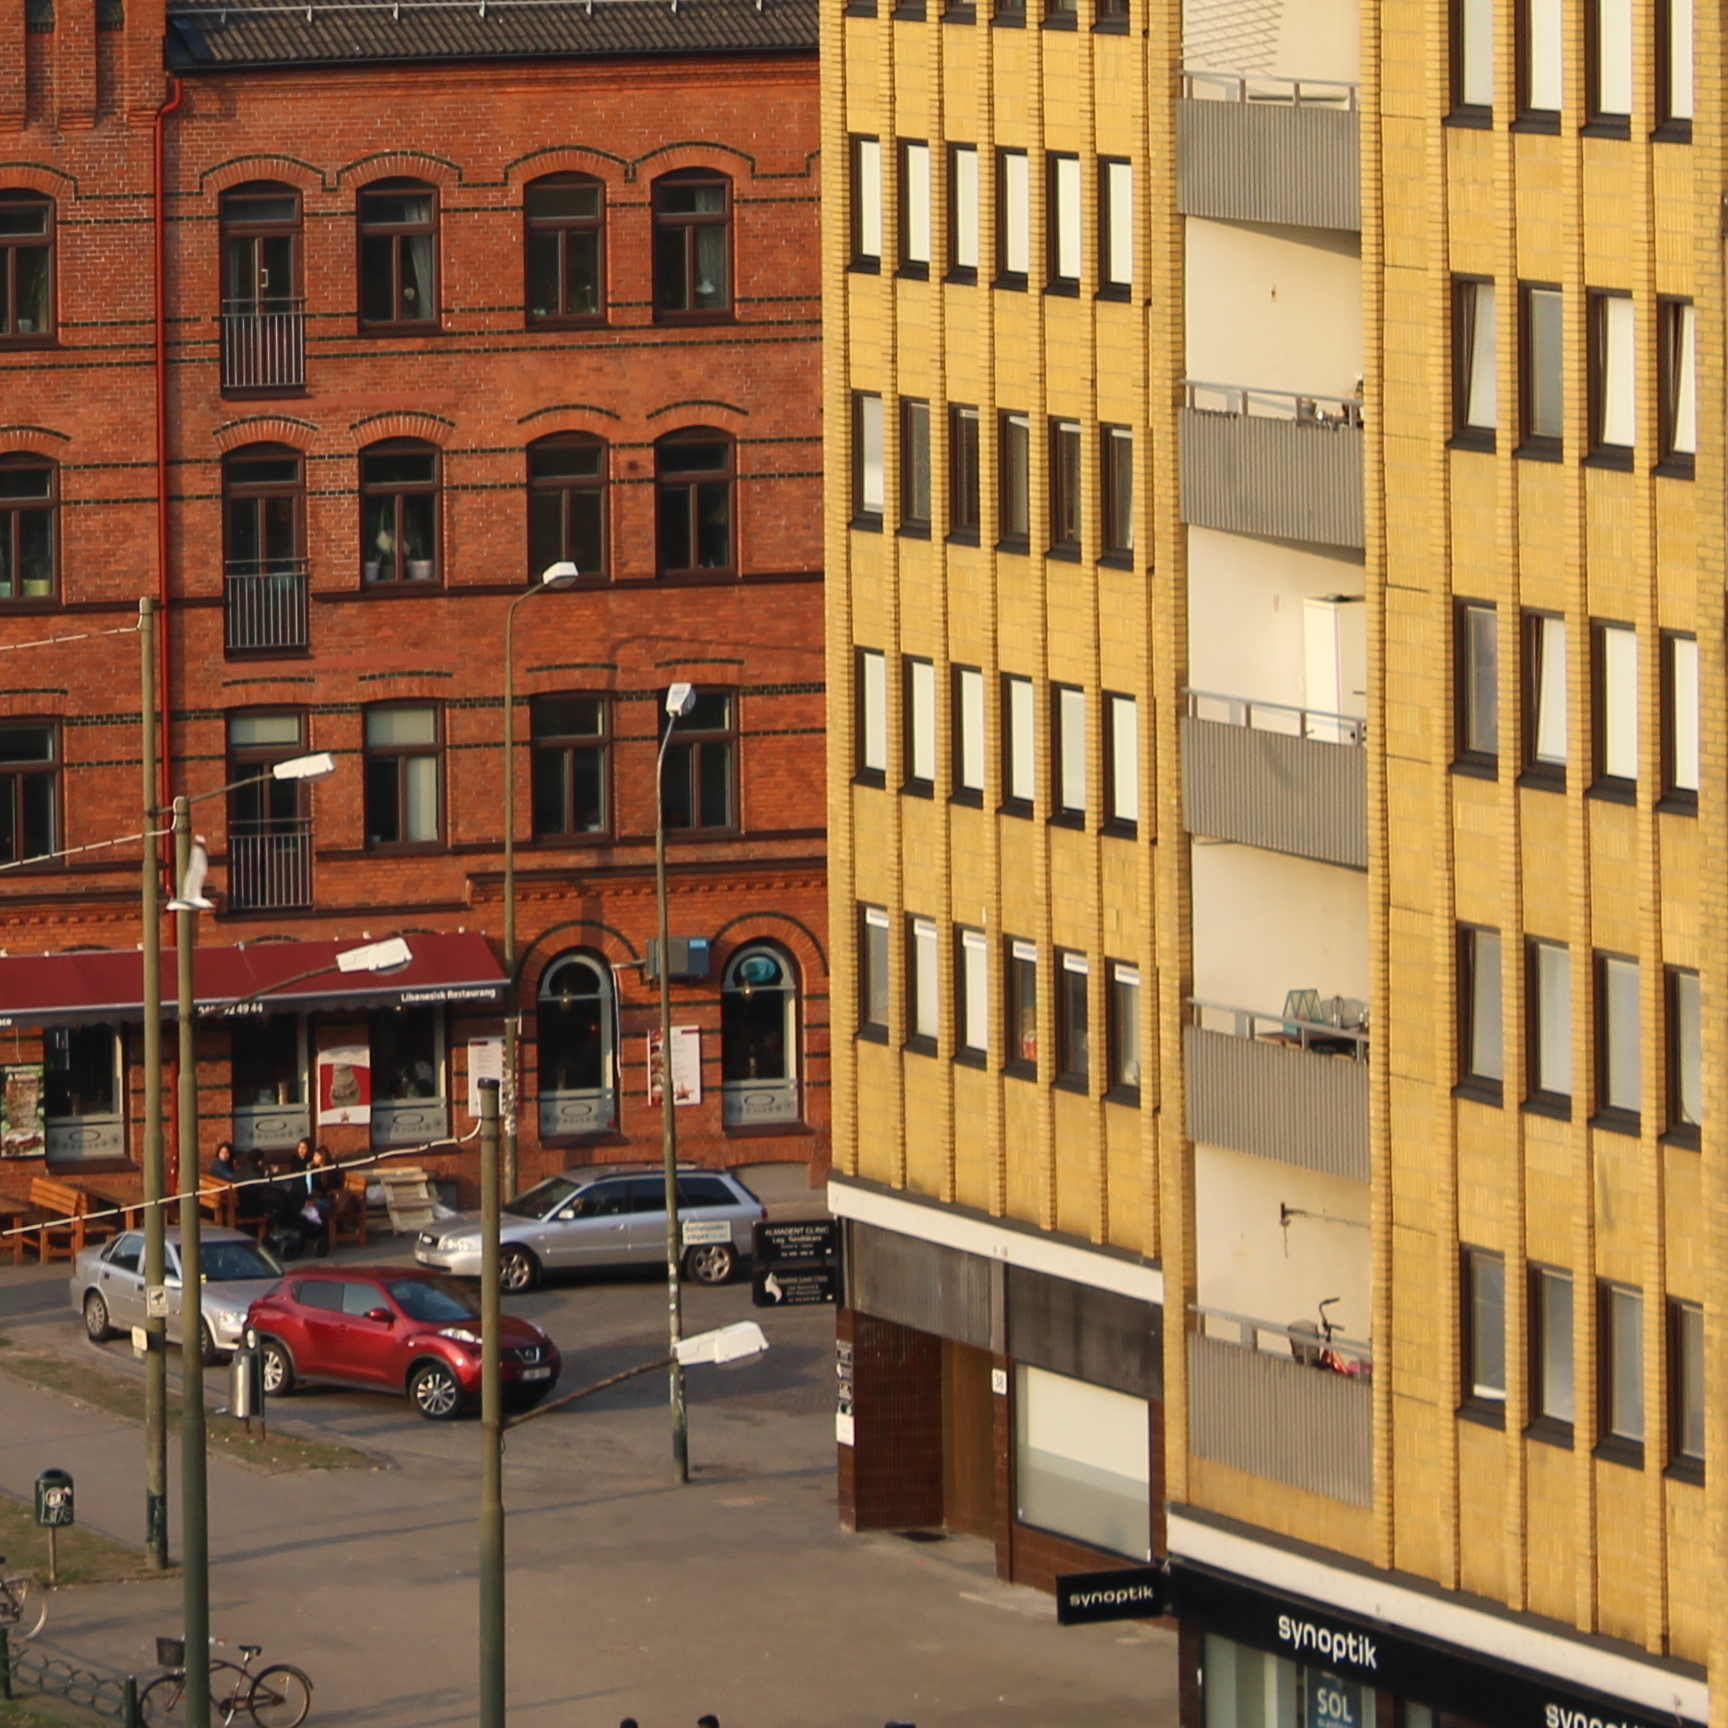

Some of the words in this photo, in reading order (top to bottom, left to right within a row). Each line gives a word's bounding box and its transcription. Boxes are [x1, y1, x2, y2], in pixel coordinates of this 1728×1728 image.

[401, 989, 446, 1003] Libanesisk
[447, 987, 496, 1001] Restaurang
[1070, 1584, 1153, 1608] synoptik
[1278, 1615, 1377, 1669] synoptik
[1317, 1687, 1353, 1724] SOL
